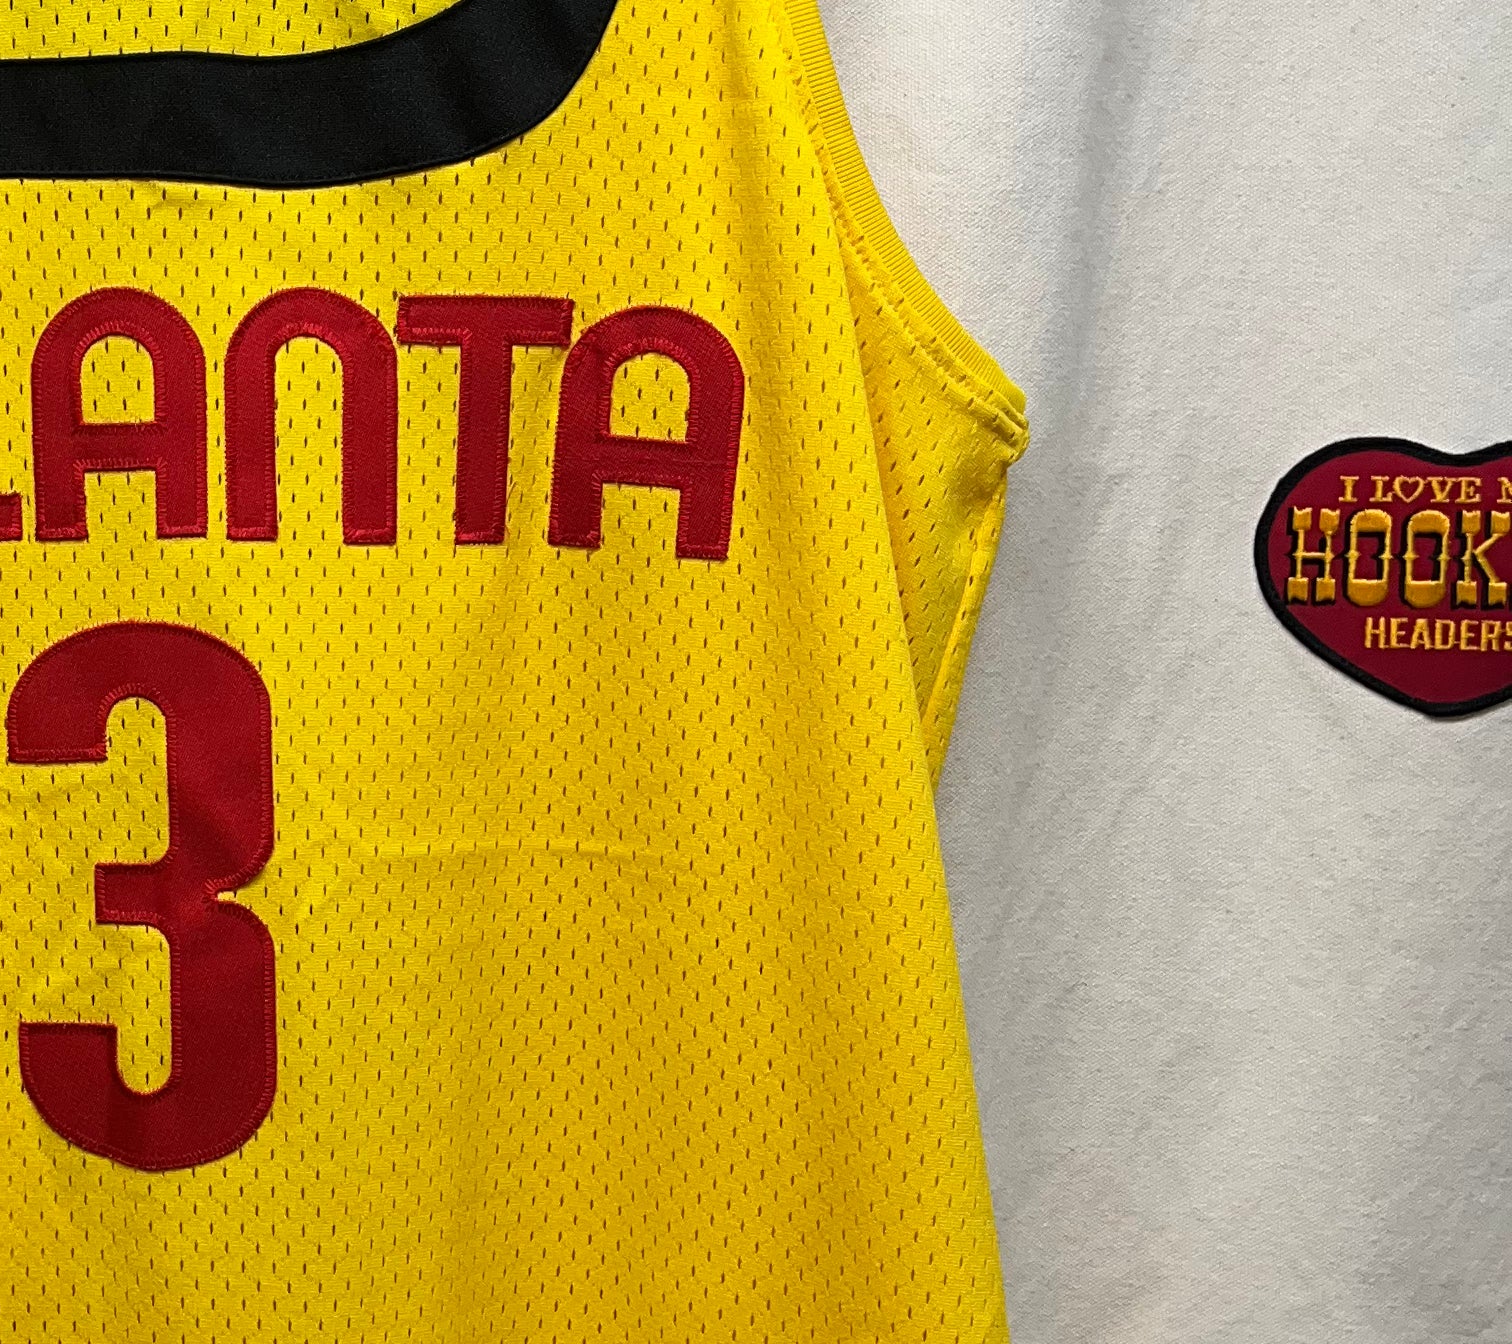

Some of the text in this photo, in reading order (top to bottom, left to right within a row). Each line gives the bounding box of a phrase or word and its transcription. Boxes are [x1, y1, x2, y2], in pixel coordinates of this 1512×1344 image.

[1338, 475, 1360, 502] I
[1285, 505, 1512, 609] HOOK
[6, 619, 278, 1171] 3
